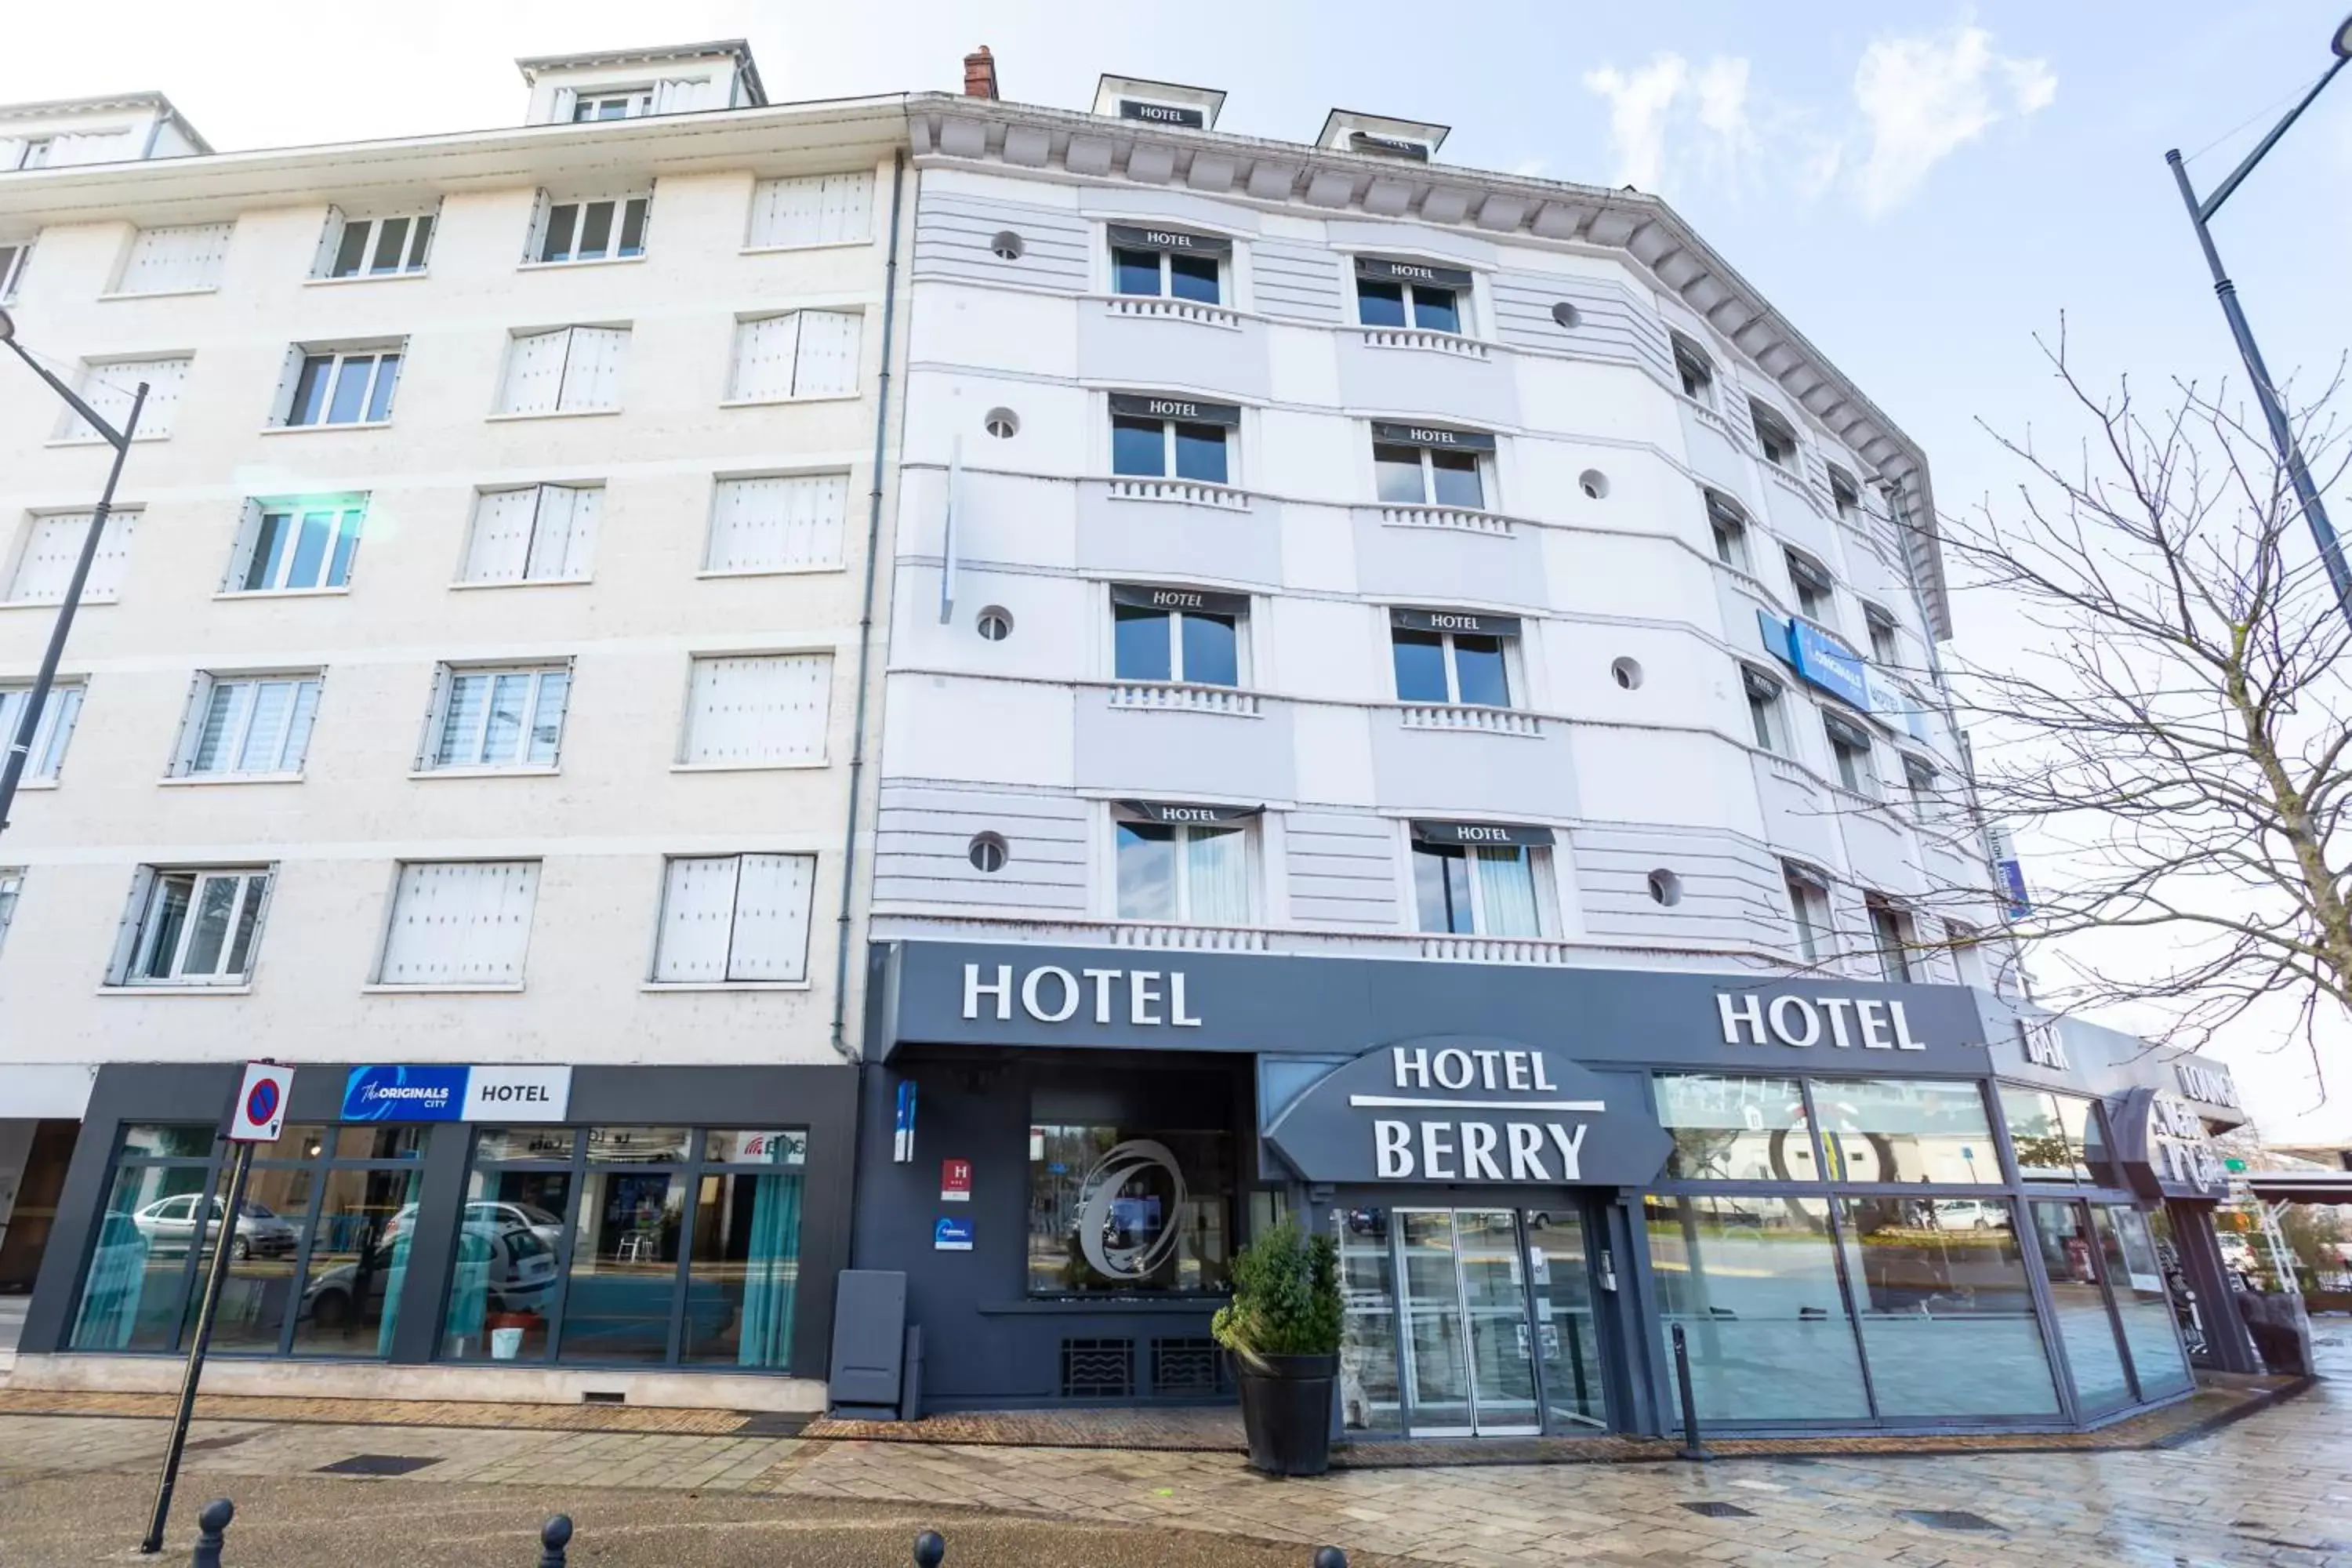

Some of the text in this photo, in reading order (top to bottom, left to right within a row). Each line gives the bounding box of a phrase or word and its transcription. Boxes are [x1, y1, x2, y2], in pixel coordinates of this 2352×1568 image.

[1142, 107, 1182, 122] HOTEL
[1147, 232, 1192, 247] HOTEL
[1392, 264, 1434, 278] HOTEL
[1150, 400, 1199, 416] HOTEL
[1410, 429, 1456, 443] HOTEL
[1153, 590, 1203, 606] HOTEL
[1431, 614, 1479, 630] HOTEL
[1163, 808, 1219, 822] HOTEL
[1457, 826, 1510, 841] HOTEL
[963, 964, 1202, 1027] HOTEL
[1716, 993, 1926, 1051] HOTEL
[2019, 1017, 2071, 1071] BAR
[1392, 1047, 1558, 1091] HOTEL
[361, 1080, 449, 1103] The ORIGINALS
[481, 1085, 550, 1102] HOTEL
[424, 1100, 448, 1109] CITY
[1374, 1119, 1588, 1181] BERRY
[954, 1165, 967, 1178] H
